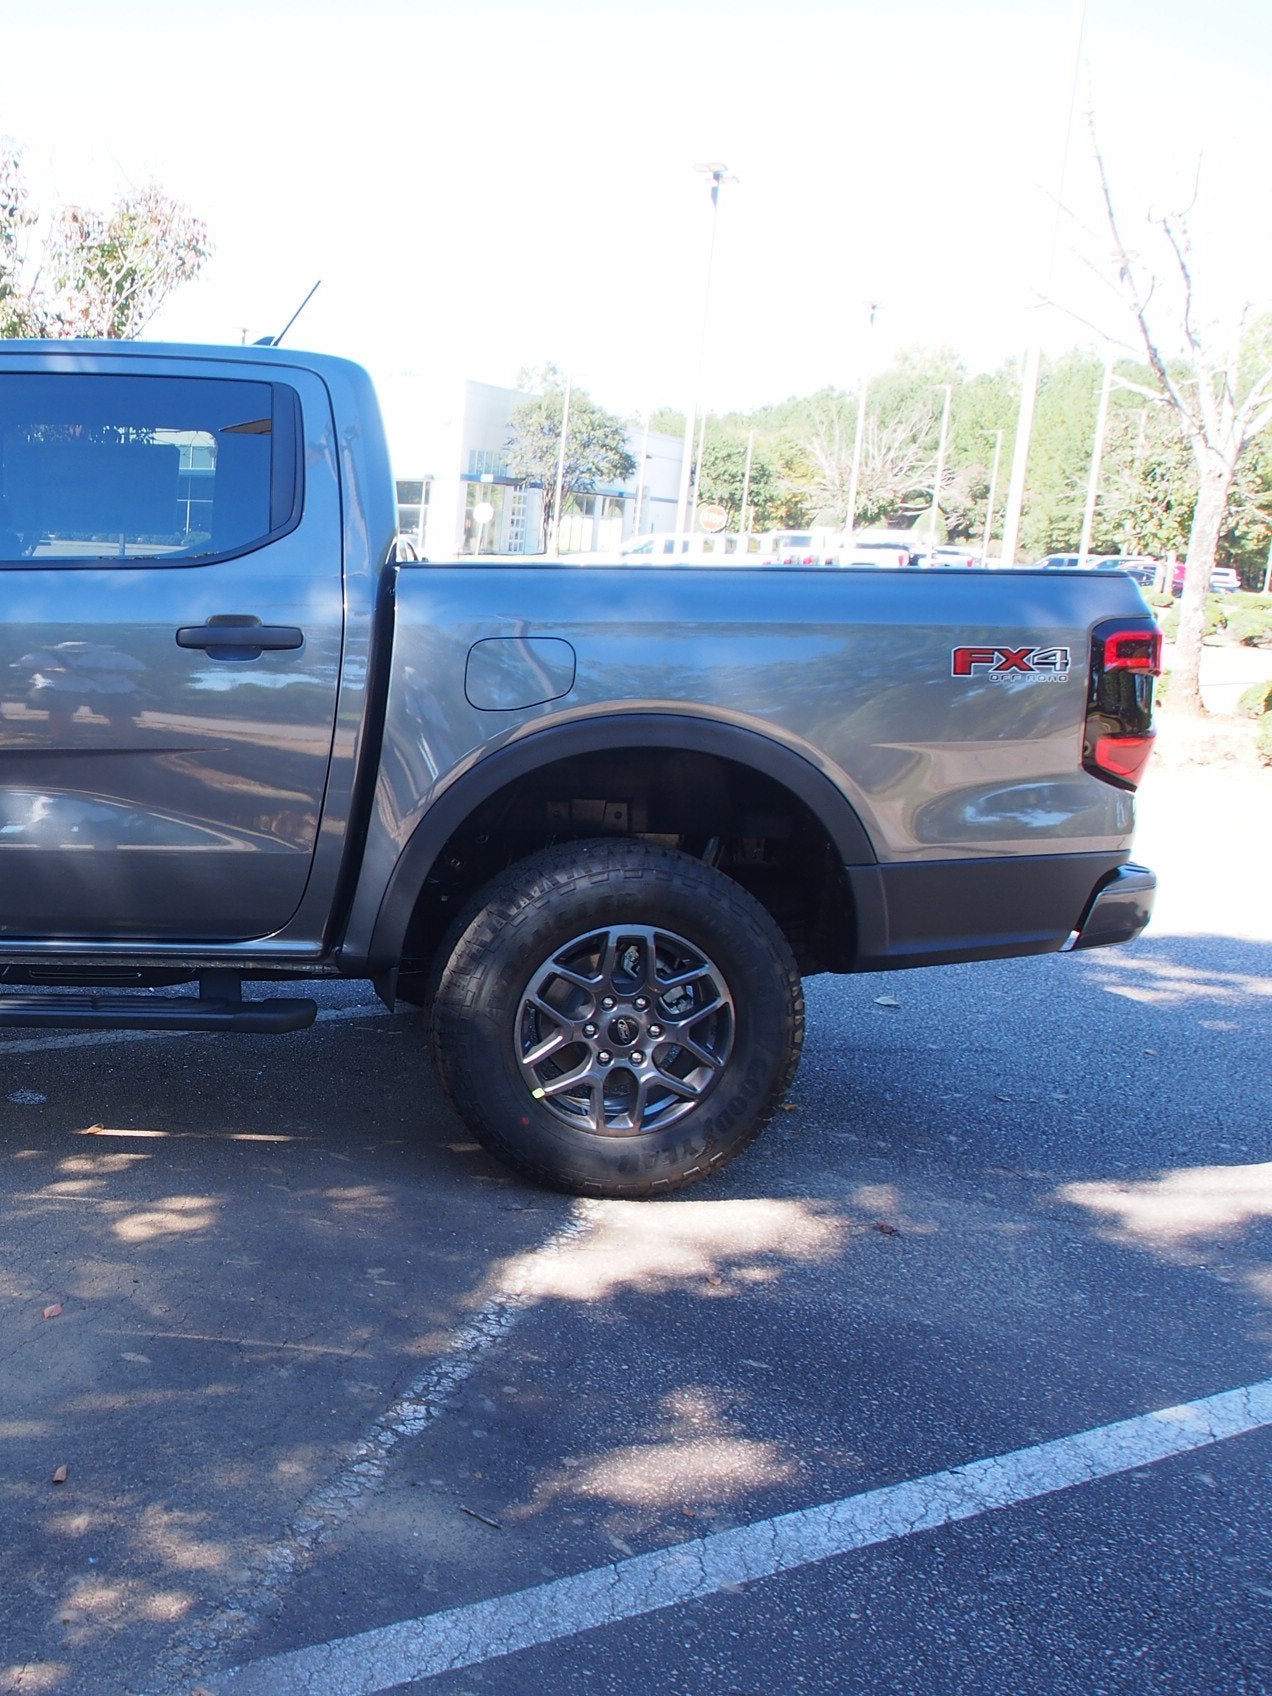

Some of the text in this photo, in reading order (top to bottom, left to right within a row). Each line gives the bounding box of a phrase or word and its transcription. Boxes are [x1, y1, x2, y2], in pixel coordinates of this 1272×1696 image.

[952, 646, 1071, 677] FX4
[989, 674, 1069, 682] OFF ROAD
